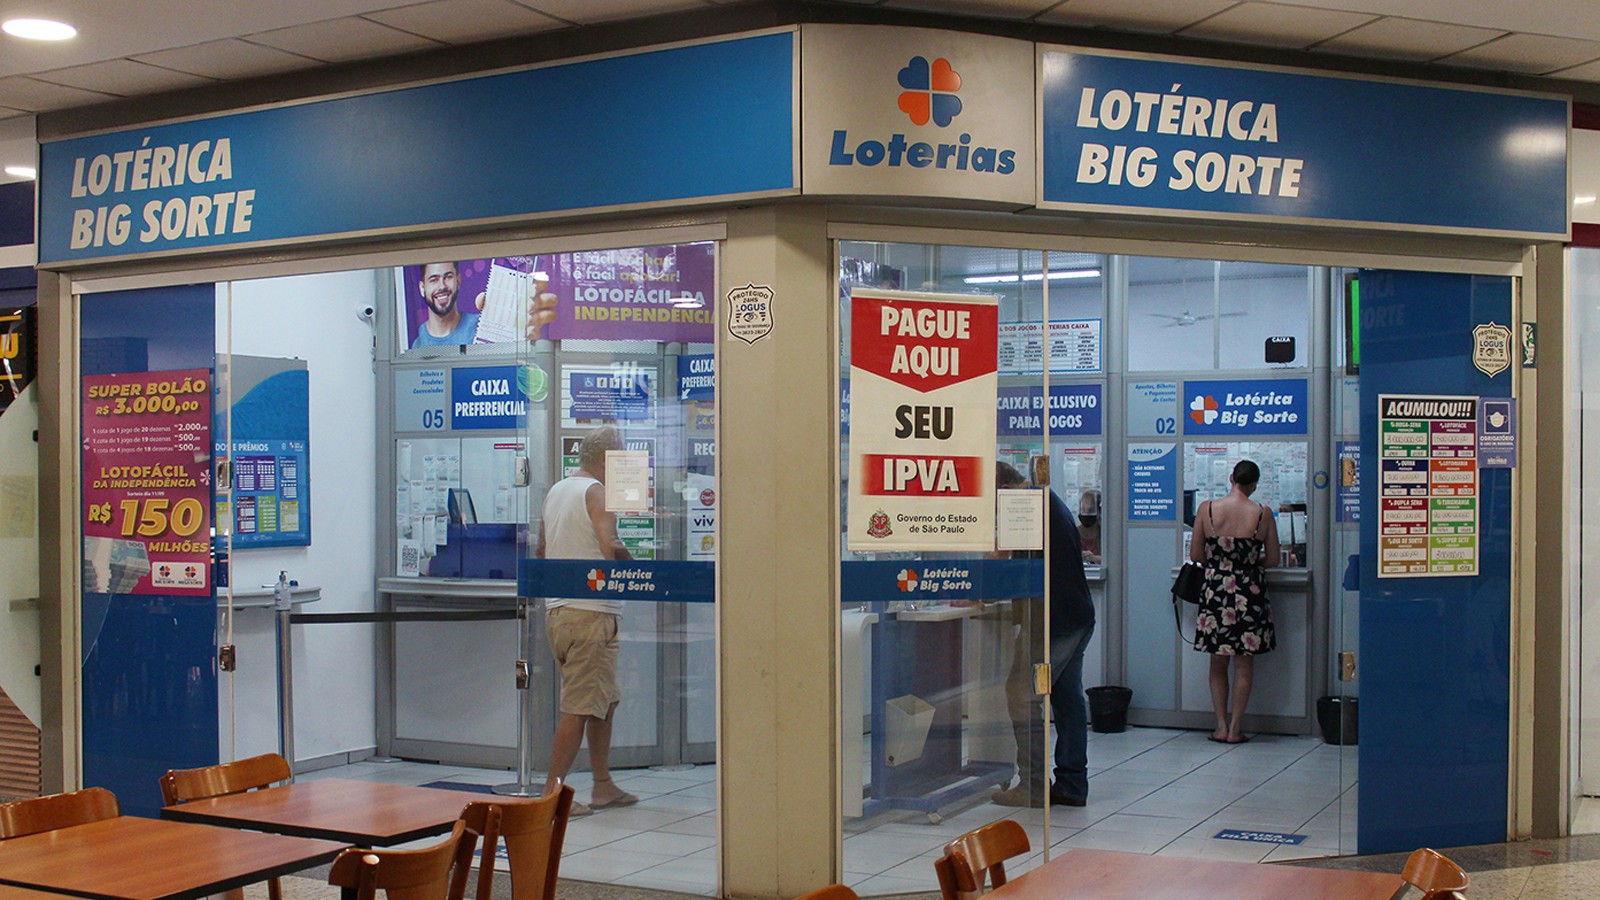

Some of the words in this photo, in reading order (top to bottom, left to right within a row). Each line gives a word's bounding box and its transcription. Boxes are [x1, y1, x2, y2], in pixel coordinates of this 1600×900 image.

[1076, 83, 1279, 143] LOTÉRICA
[829, 129, 1016, 175] Loterias
[71, 136, 232, 198] LOTÉRICA
[1076, 143, 1158, 188] BIG
[1168, 149, 1304, 198] SORTE
[70, 203, 132, 250] BIG
[139, 189, 256, 243] SORTE
[586, 265, 616, 280] fácil
[574, 285, 673, 304] LOTOFÁCIL
[680, 290, 706, 305] DA
[736, 302, 766, 312] LOGUS
[880, 306, 971, 340] PAGUE
[1480, 340, 1504, 348] LOGUS
[690, 359, 715, 373] CAIXA
[890, 344, 960, 379] AQUI
[88, 383, 142, 398] SUPER
[146, 377, 207, 396] BOLÃO
[471, 379, 510, 396] CAIXA
[95, 405, 110, 416] R$
[113, 395, 200, 415] 3.000,00
[997, 397, 1030, 410] CAIXA
[1225, 391, 1294, 407] Lotérica
[455, 400, 526, 417] PREFERENCIAL
[1386, 401, 1472, 417] ACUMULOU!!!
[422, 409, 444, 429] 05
[895, 404, 954, 440] SEU
[1009, 415, 1041, 429] PARA
[1049, 414, 1083, 429] OGOS
[1155, 417, 1176, 435] 02
[1220, 410, 1249, 427] Big
[1252, 410, 1298, 424] Sorte
[238, 440, 269, 452] PRÊMIOS
[101, 463, 188, 479] LOTOFÁCIL
[883, 458, 960, 493] IPVA
[93, 480, 108, 489] DA
[110, 477, 197, 489] INDEPENDÊNCIA
[88, 502, 112, 524] R$
[120, 497, 203, 537] 150
[694, 515, 715, 527] viv
[873, 516, 887, 525] SP
[896, 513, 933, 522] Governo
[934, 514, 946, 522] do
[948, 514, 978, 523] Estado
[909, 525, 920, 533] de
[922, 524, 938, 533] São
[940, 525, 965, 533] Paulo
[148, 540, 208, 553] MILHÕES
[610, 568, 653, 580] Lotérica
[923, 567, 969, 578] Lotérica
[608, 580, 625, 592] Big
[628, 580, 656, 592] Sorte
[920, 579, 940, 592] Big
[942, 580, 972, 590] Sorte
